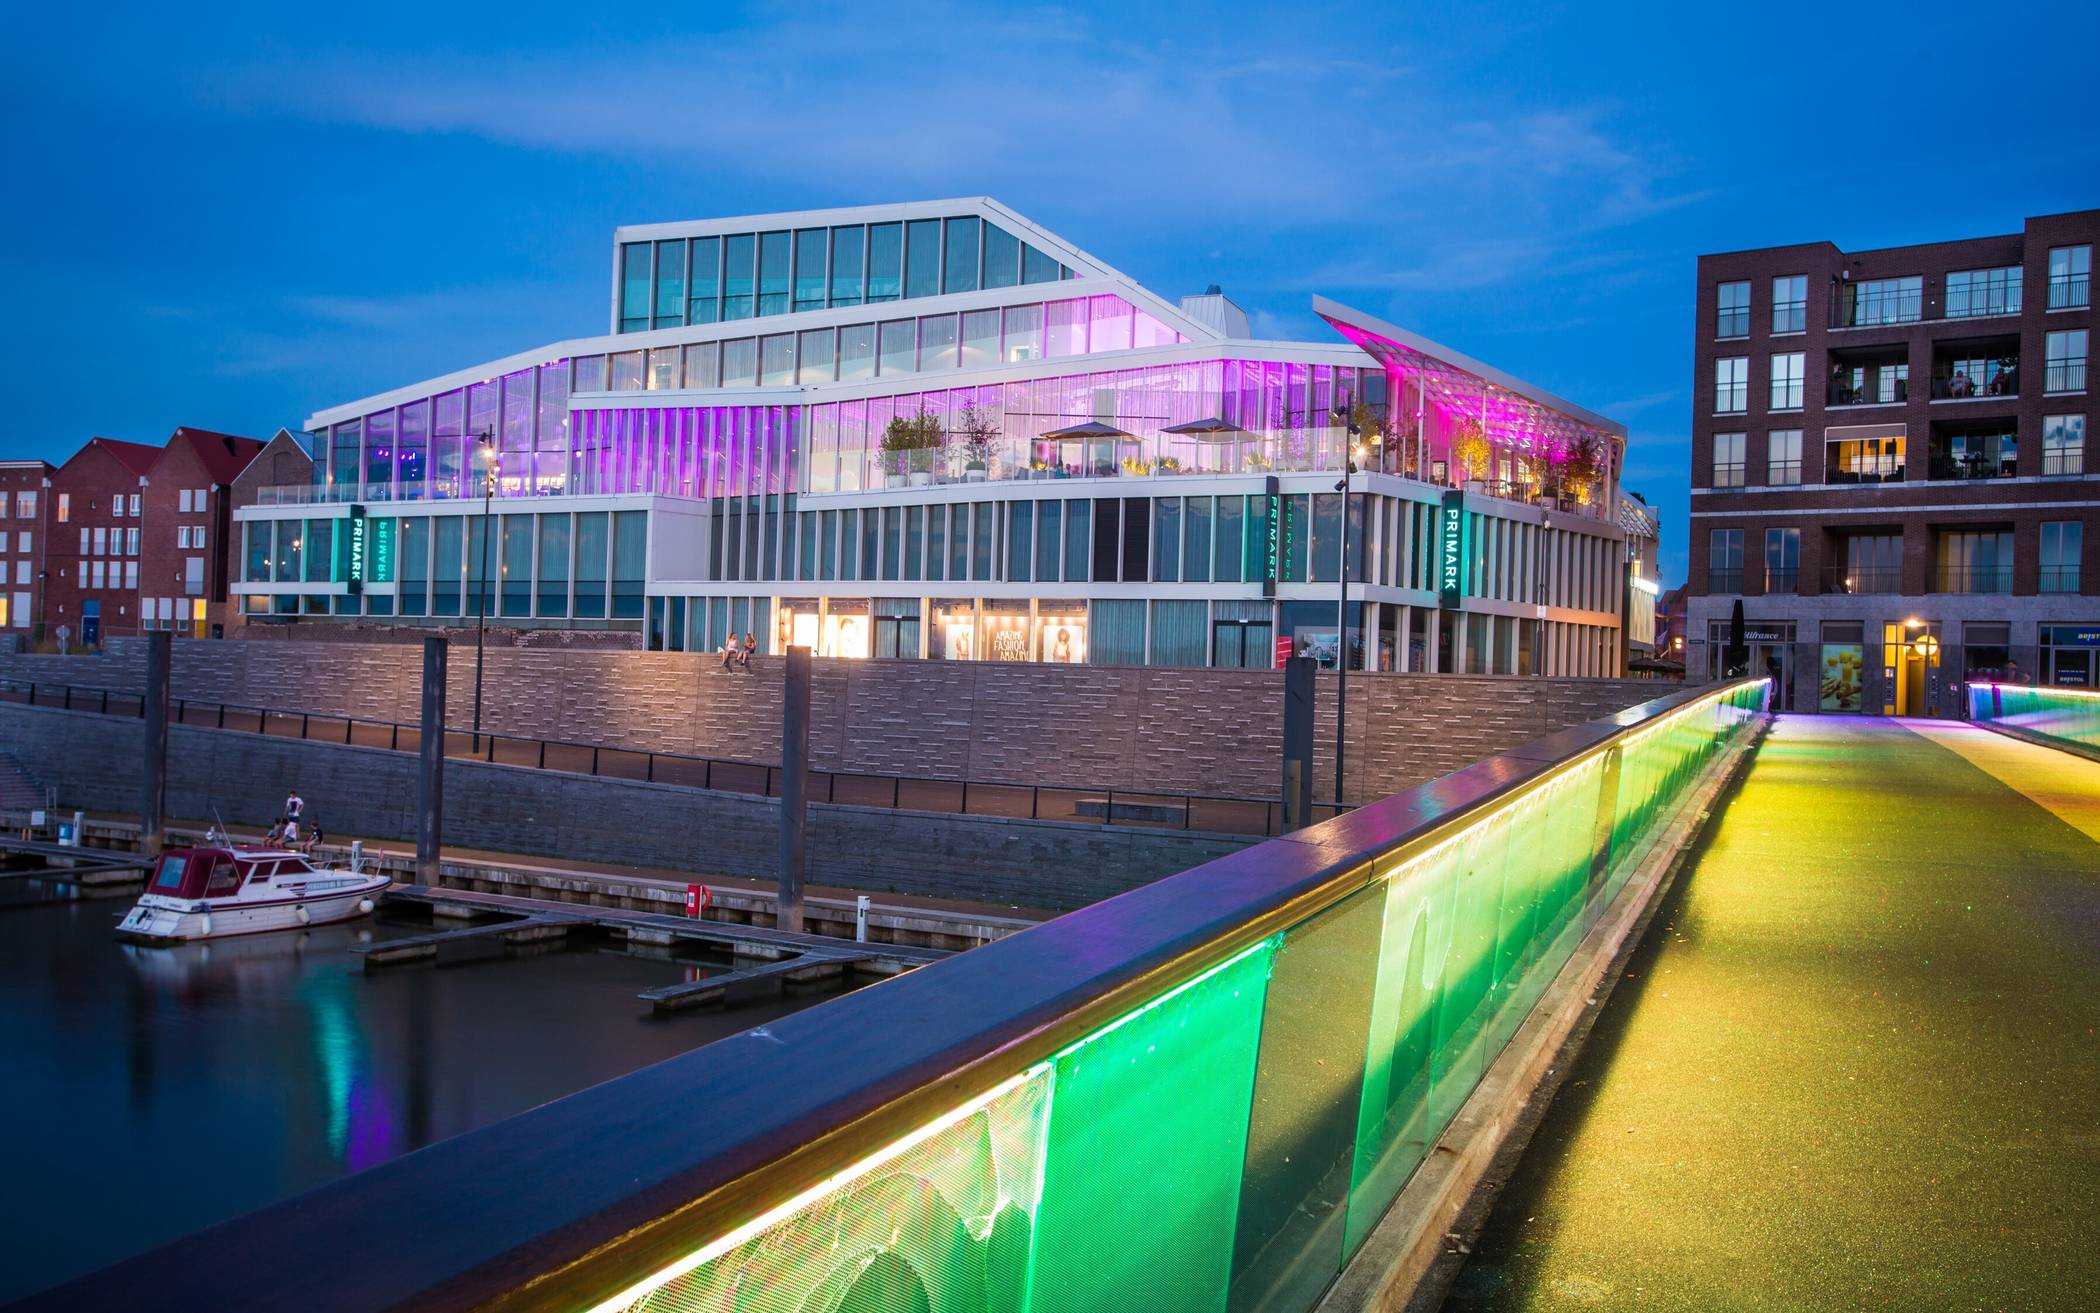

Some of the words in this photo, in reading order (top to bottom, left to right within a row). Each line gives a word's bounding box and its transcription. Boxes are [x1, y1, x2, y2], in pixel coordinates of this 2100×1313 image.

[352, 518, 363, 580] PRIMARK
[1268, 496, 1278, 579] PRIMARK
[1445, 509, 1459, 589] PRIMARK
[993, 640, 1025, 652] FASHION
[995, 630, 1024, 641] AMAZING
[1727, 630, 1779, 640] lifrance
